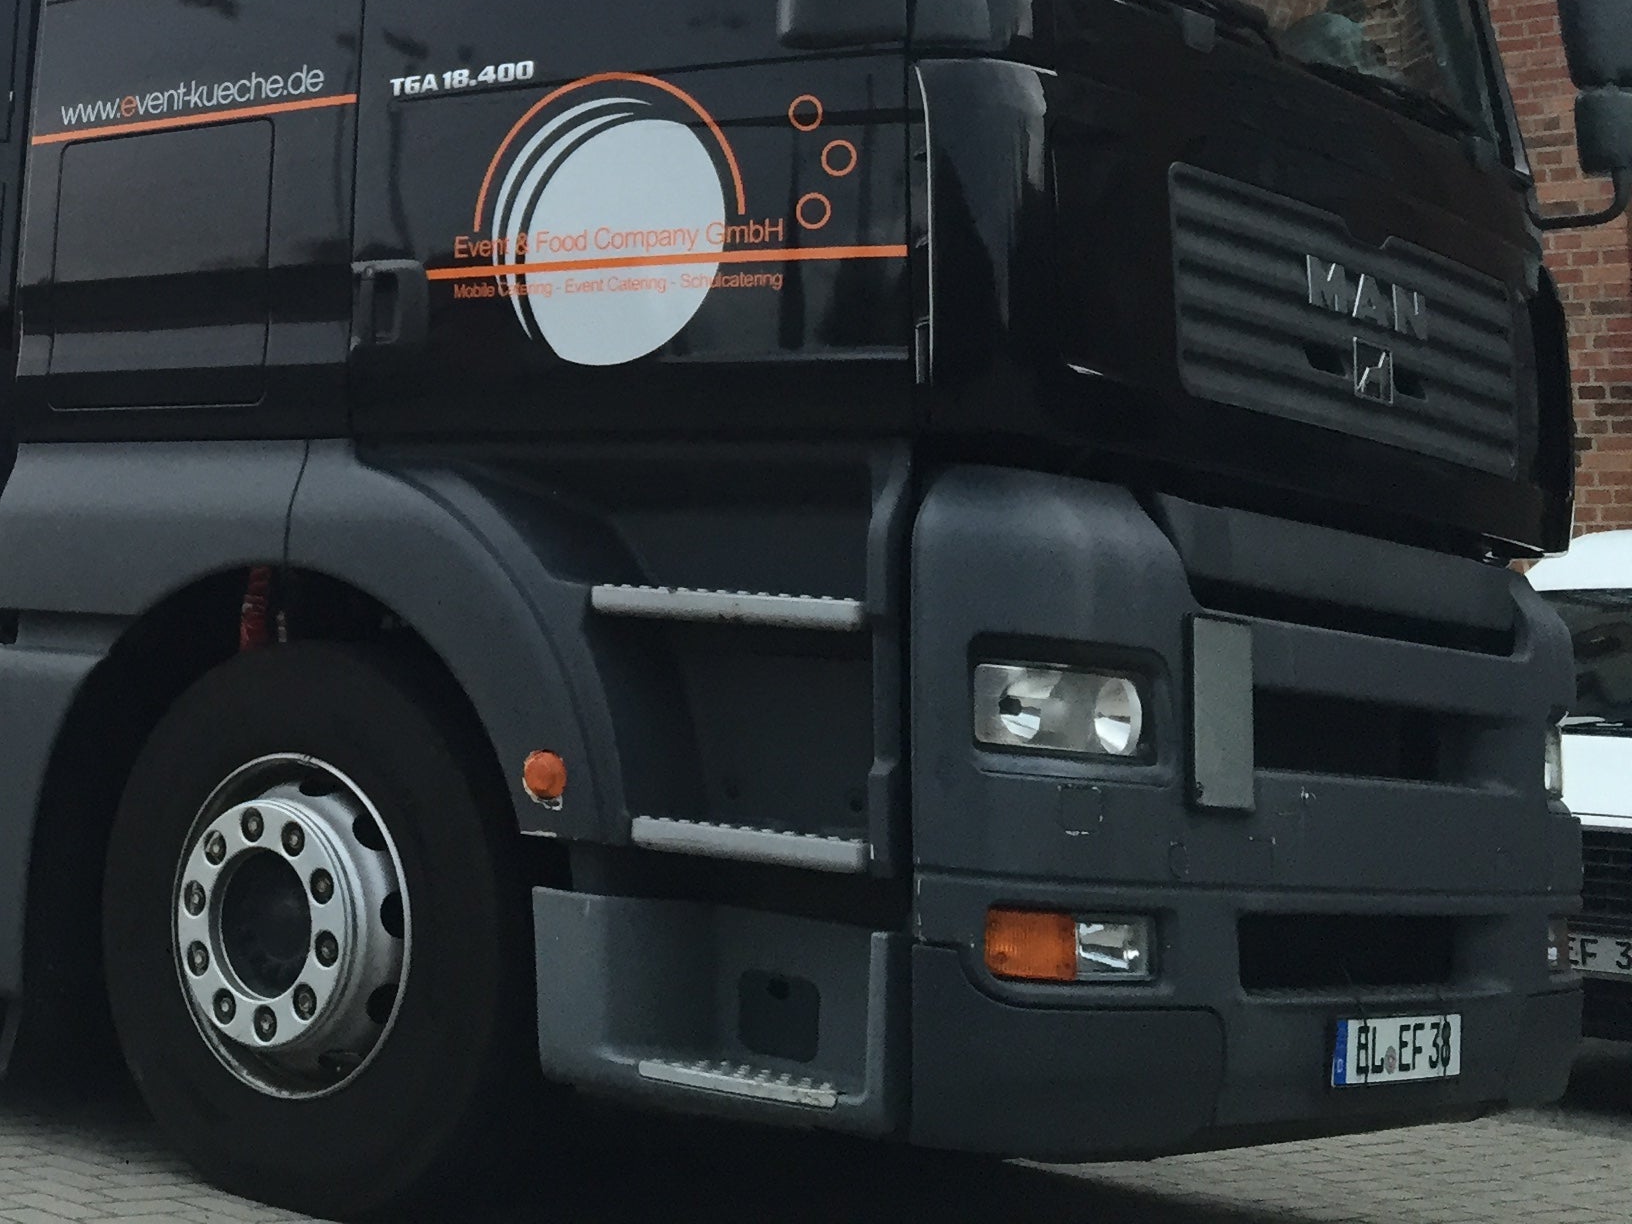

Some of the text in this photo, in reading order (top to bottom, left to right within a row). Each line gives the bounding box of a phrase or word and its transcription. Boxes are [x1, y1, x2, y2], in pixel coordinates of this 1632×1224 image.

[60, 64, 325, 126] www.event-kueche.de
[390, 60, 535, 97] TGA 18.400
[453, 217, 784, 259] Event & Food Company GmbH
[453, 283, 495, 299] Mobile
[497, 280, 553, 297] Catering
[565, 277, 605, 294] Event
[607, 275, 667, 294] Catering
[680, 272, 784, 291] Schulcatering
[1305, 252, 1429, 342] MAN
[1399, 1023, 1426, 1072] EF
